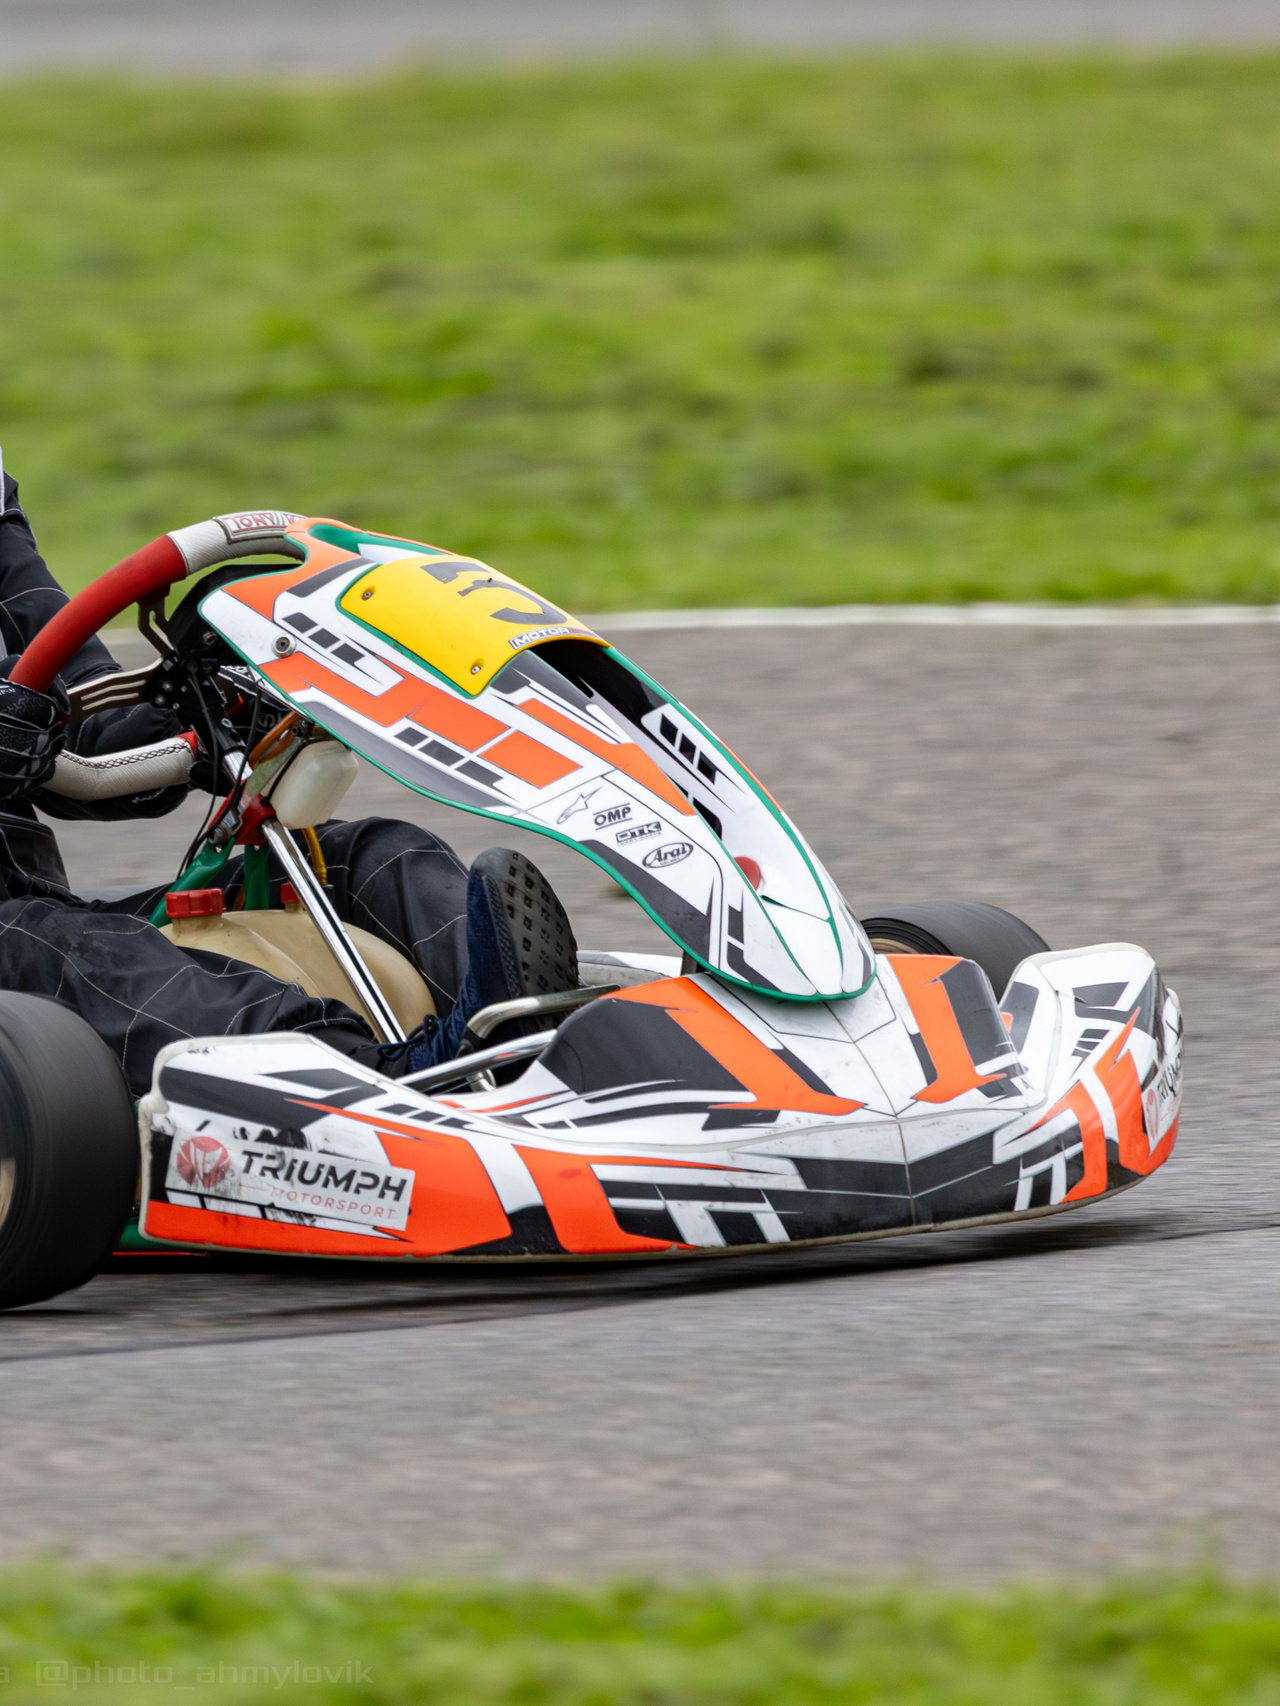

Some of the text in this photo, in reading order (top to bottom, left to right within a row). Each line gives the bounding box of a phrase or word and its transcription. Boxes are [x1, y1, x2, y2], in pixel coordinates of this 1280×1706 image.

[223, 513, 276, 529] TONY
[594, 806, 632, 826] OMP
[616, 822, 661, 842] OTK
[647, 843, 687, 866] Arai
[242, 1150, 408, 1203] TRIUMPH
[270, 1186, 397, 1220] MOTORSPORT
